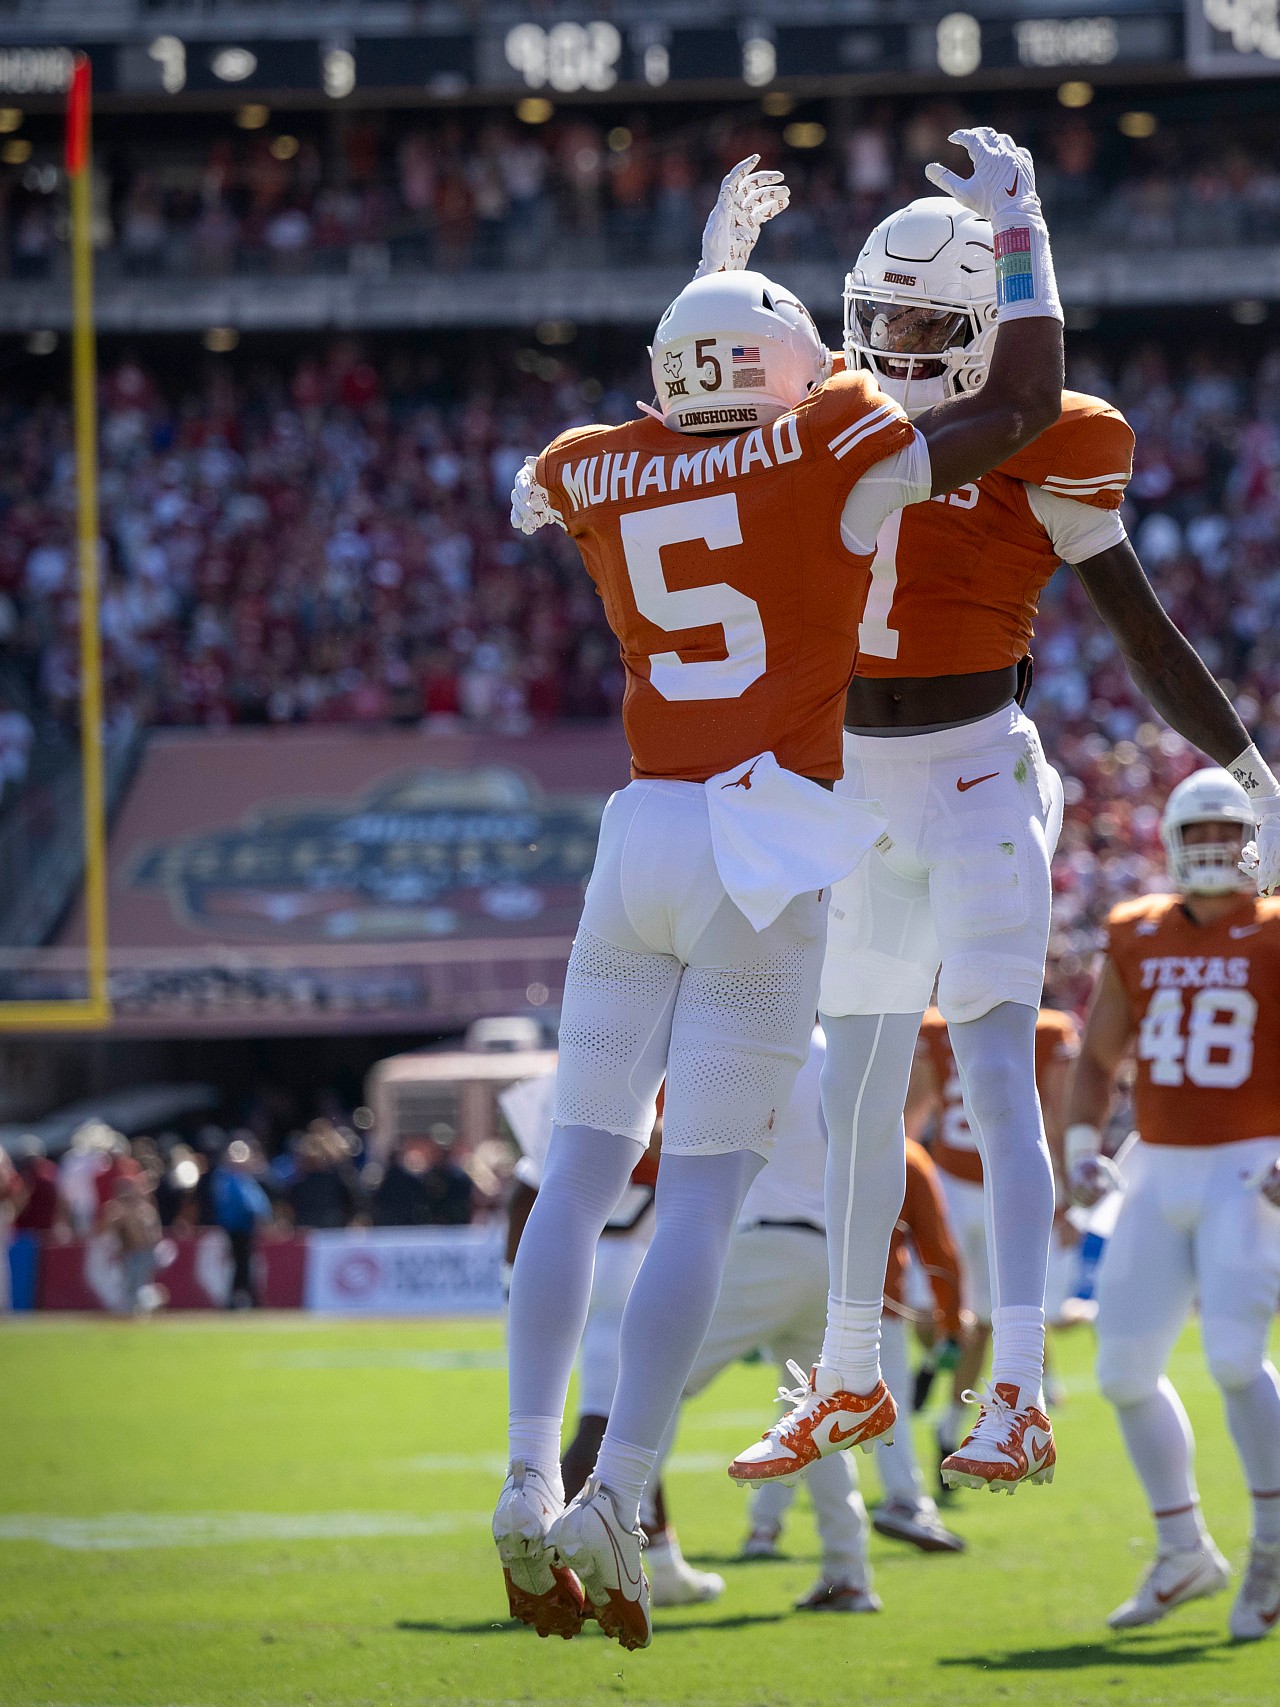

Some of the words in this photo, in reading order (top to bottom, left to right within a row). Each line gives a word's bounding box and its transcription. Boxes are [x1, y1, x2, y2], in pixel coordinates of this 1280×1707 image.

[882, 271, 917, 287] HORNS
[695, 338, 722, 391] 5
[678, 408, 758, 428] LONGHORNS
[561, 414, 803, 512] MUHAMMAD
[620, 493, 766, 701] 5
[1140, 956, 1250, 989] TEXAS
[1138, 988, 1259, 1090] 48
